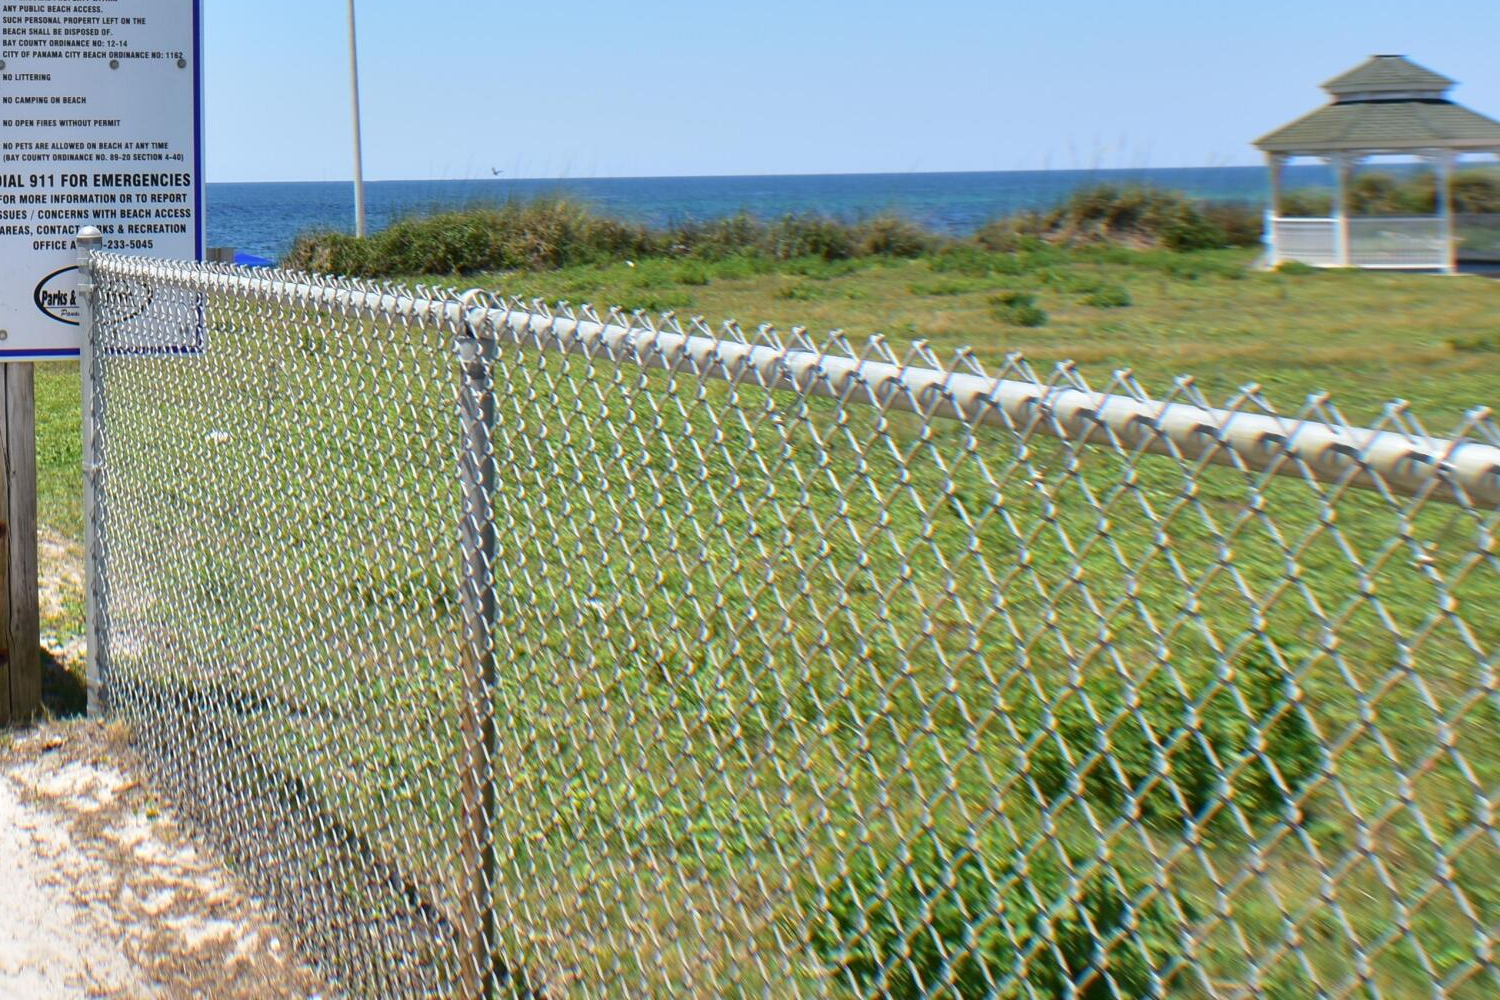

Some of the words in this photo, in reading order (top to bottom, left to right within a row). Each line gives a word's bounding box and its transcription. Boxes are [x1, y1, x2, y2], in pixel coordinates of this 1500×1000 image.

[64, 28, 99, 36] DISPOSED
[101, 28, 112, 36] OF.
[2, 39, 16, 47] BAY
[18, 39, 47, 47] COUNTY
[108, 51, 149, 59] ORDINANCE
[2, 119, 13, 127] NO
[15, 119, 34, 127] OPEN
[36, 119, 57, 127] FIRES
[59, 119, 91, 127] WITHOUT
[93, 119, 120, 127] PERMIT
[2, 142, 13, 150] NO
[15, 142, 33, 150] PETS
[35, 142, 49, 150] ARE
[51, 142, 84, 150] ALLOWED
[3, 154, 19, 162] (BAY
[21, 153, 50, 162] COUNTY
[52, 153, 93, 162] ORDINANCE
[109, 153, 131, 162] 89-20
[133, 153, 163, 161] SECTION
[29, 174, 54, 187] 911
[61, 174, 88, 187] FOR
[93, 173, 190, 187] EMERGENCIES
[19, 194, 47, 204] MORE
[50, 194, 116, 203] INFORMATION
[119, 193, 132, 203] OR
[135, 193, 147, 203] TO
[150, 193, 187, 203] REPORT
[30, 209, 34, 219] /
[37, 209, 89, 219] CONCERNS
[92, 209, 116, 219] WITH
[119, 209, 151, 218] BEACH
[154, 208, 191, 218] ACCESS
[0, 226, 33, 236] AREAS,
[36, 225, 78, 234] CONTACT
[117, 224, 124, 233] &
[128, 224, 186, 233] RECREATION
[33, 241, 66, 250] OFFICE
[70, 240, 77, 249] A
[101, 240, 153, 249] -233-5045
[42, 290, 68, 306] Parks
[69, 290, 77, 305] &
